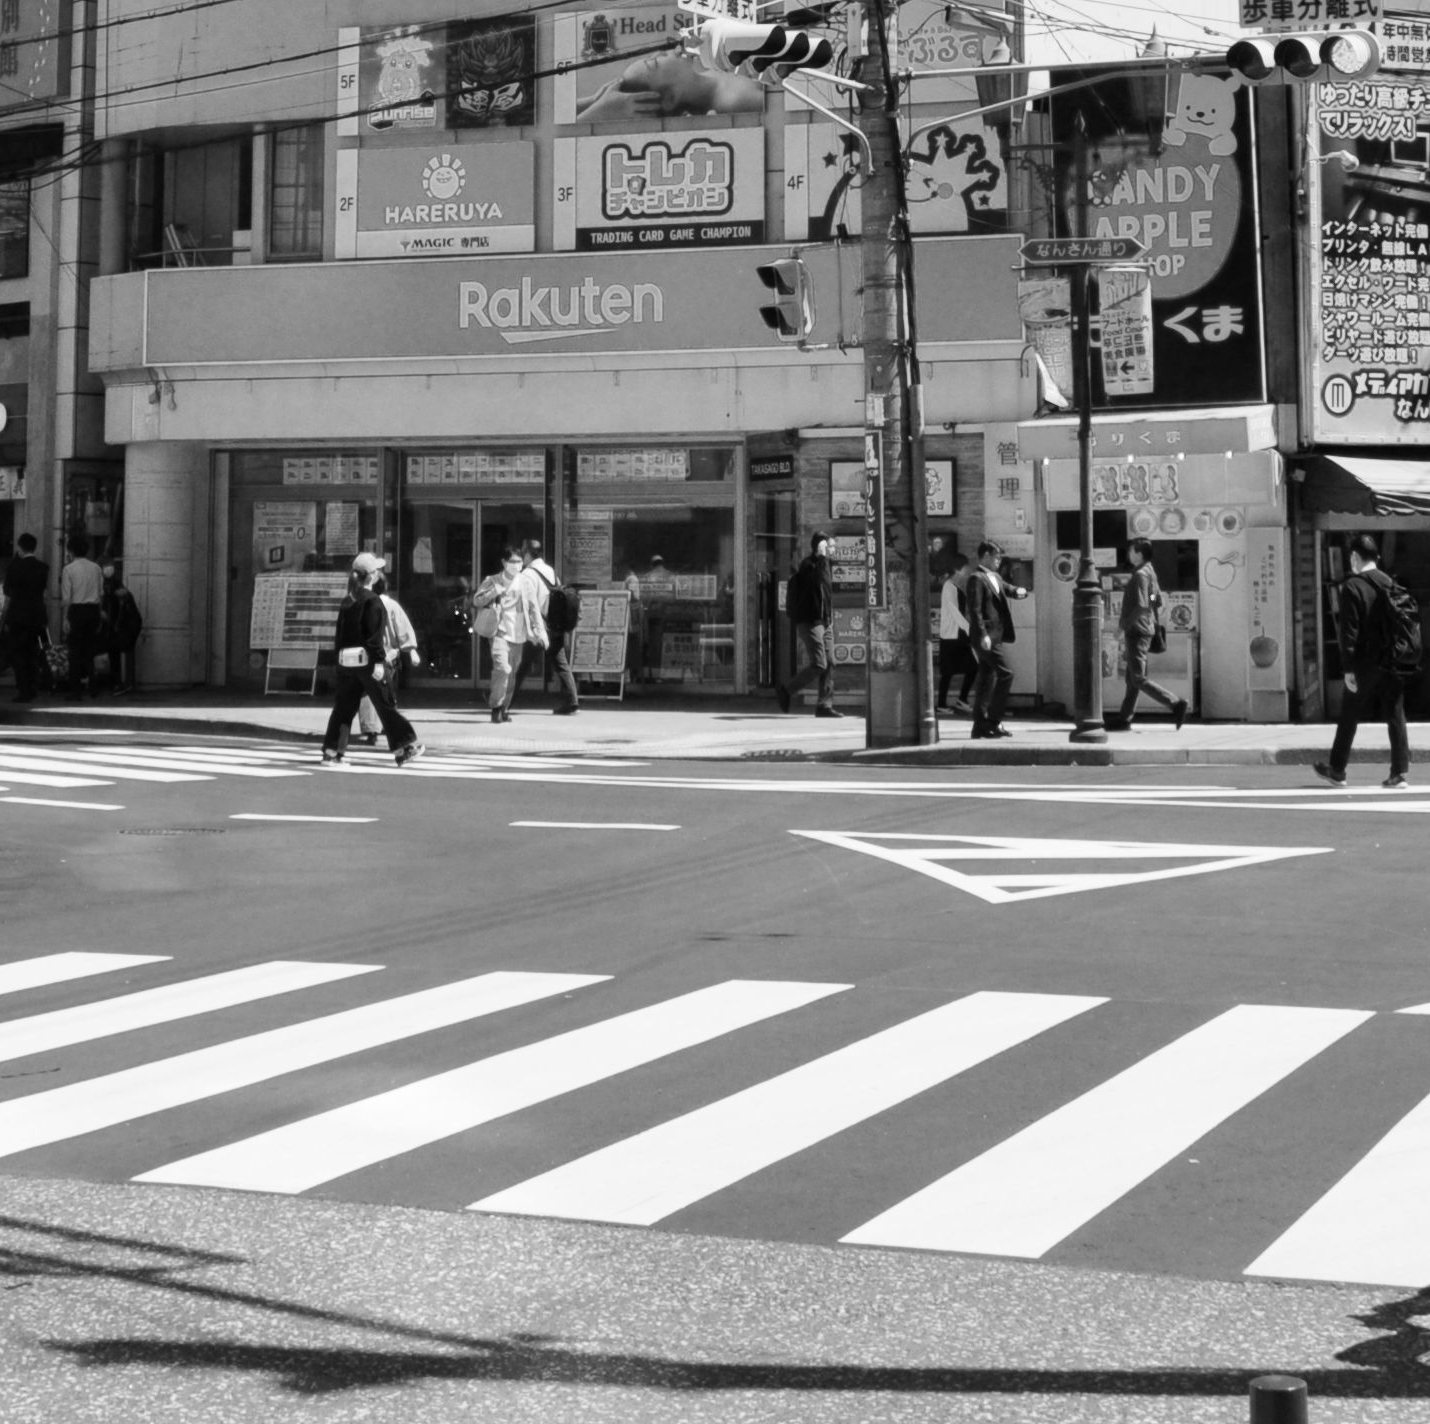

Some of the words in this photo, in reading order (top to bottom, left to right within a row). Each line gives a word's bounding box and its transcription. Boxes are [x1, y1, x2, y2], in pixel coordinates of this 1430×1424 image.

[620, 15, 667, 35] Head
[340, 74, 356, 89] 5F
[610, 146, 726, 189] トレカ
[786, 175, 804, 190] 4F
[1088, 163, 1220, 206] ANDY
[339, 196, 354, 212] 2F
[557, 187, 573, 203] 3F
[609, 187, 726, 213] チャンピオン
[385, 203, 503, 225] HARERUYA
[411, 237, 455, 249] MAGIC
[460, 236, 491, 249] 専門店
[590, 231, 634, 245] TRADING
[638, 229, 665, 243] CARD
[669, 228, 695, 241] GAME
[700, 225, 752, 240] CHAMPION
[1036, 239, 1127, 258] なんさん通り
[458, 275, 664, 333] Rakuten
[997, 442, 1020, 501] 管理
